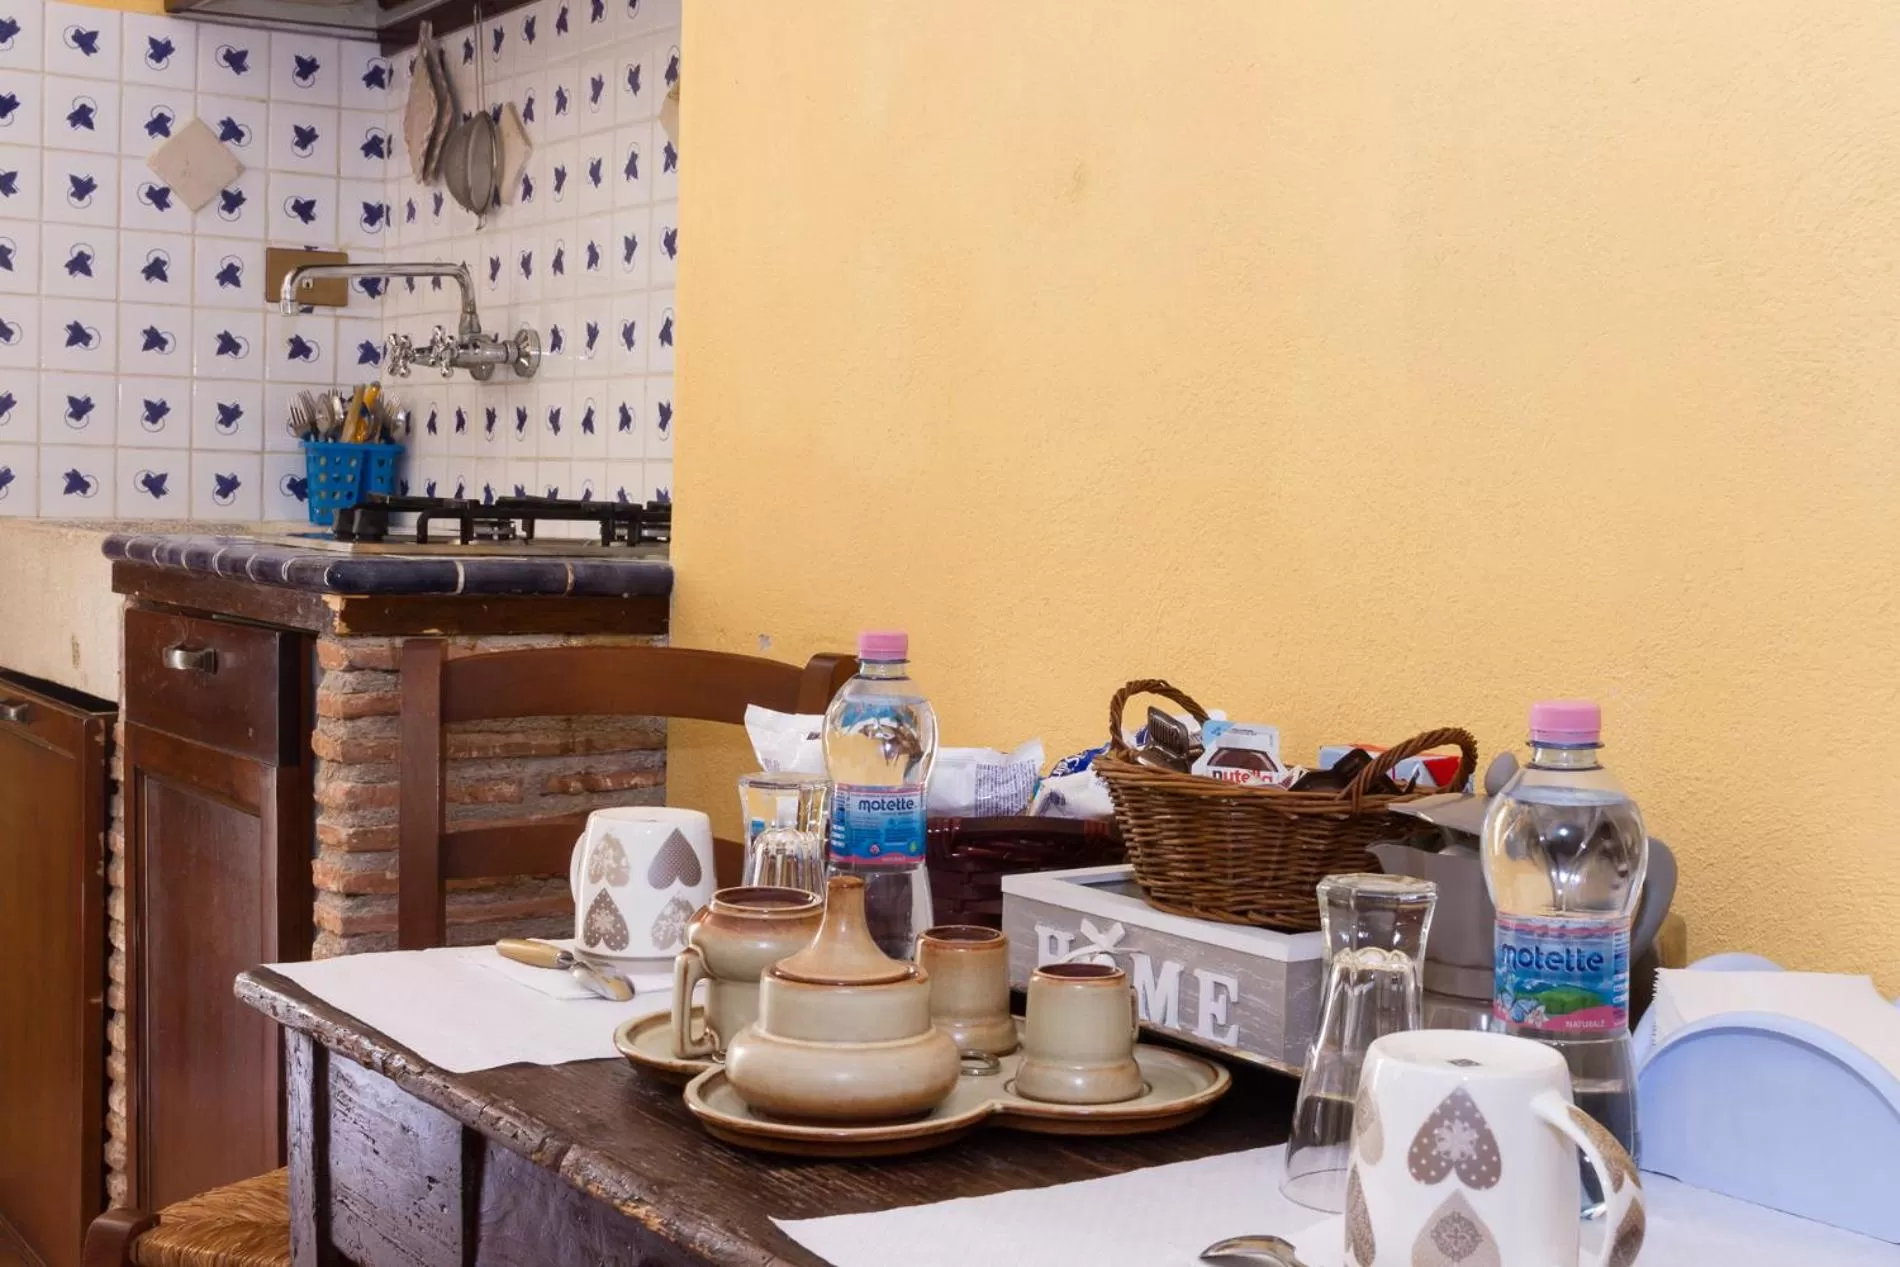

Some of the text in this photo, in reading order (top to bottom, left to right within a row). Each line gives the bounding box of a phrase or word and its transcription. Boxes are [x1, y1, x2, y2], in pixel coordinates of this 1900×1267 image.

[858, 797, 914, 813] motette
[1501, 943, 1604, 972] motette
[1565, 1019, 1606, 1029] NATURALE
